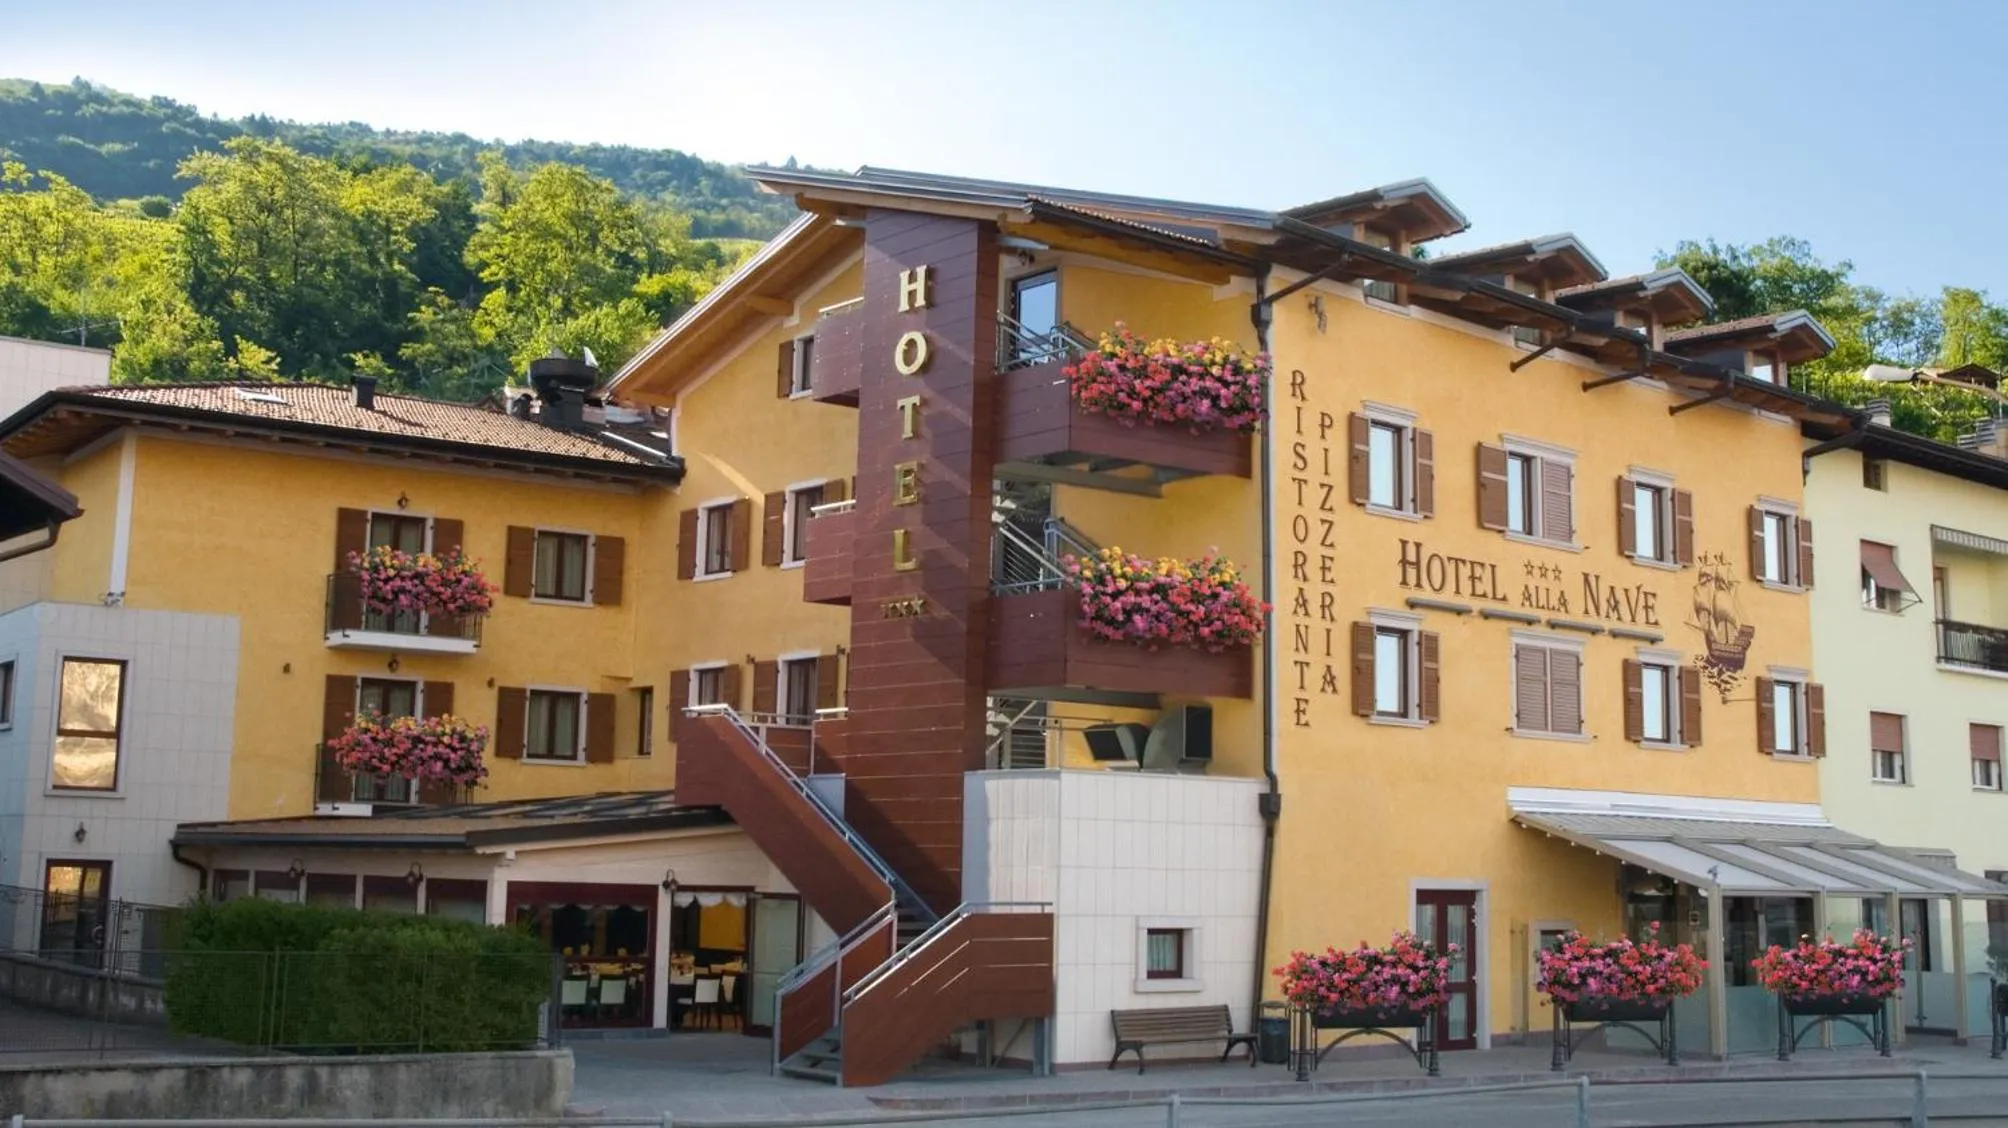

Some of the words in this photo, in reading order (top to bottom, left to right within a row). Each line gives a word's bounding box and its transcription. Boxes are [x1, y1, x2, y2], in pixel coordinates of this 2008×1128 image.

[894, 264, 929, 572] HOTEL
[1290, 369, 1310, 728] RISTORANTE
[1319, 411, 1339, 695] PIZZERIA
[1397, 538, 1508, 602] HOTEL
[1520, 583, 1570, 615] ALLA
[1582, 571, 1661, 626] NAVE
